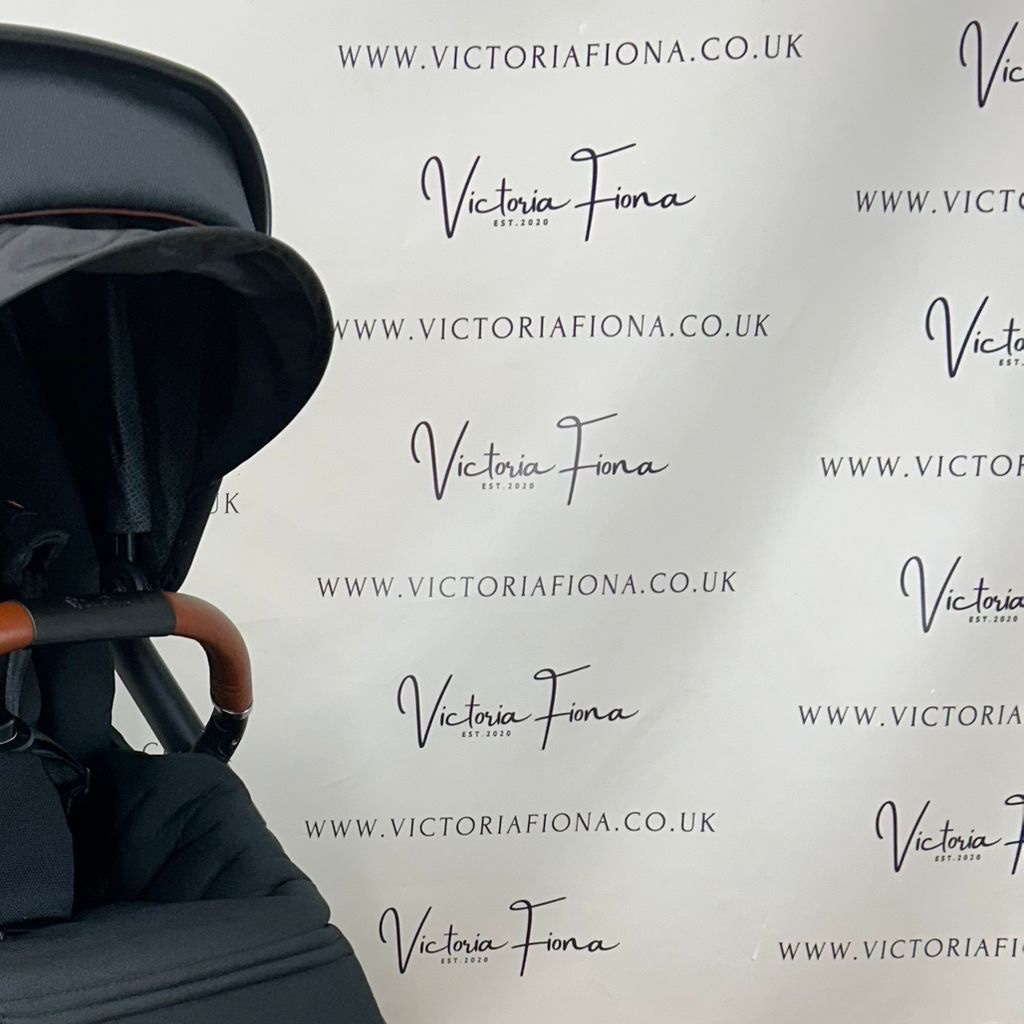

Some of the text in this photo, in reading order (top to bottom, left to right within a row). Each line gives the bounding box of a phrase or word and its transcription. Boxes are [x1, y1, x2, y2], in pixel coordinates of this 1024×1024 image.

[338, 34, 804, 71] WWW.VICTORIAFIONA.CO.UK
[421, 143, 697, 242] Victoria Fiona
[493, 218, 549, 228] EST.2020
[410, 413, 670, 506] Victoria Fiona
[481, 482, 535, 490] EST.2020
[317, 571, 737, 598] WWW.VICTORIAFIONA.CO.UK
[900, 556, 1024, 634] Victoria
[969, 615, 1018, 623] EST.2020
[397, 664, 639, 750] Victoria Fiona
[799, 704, 1023, 727] WWW.VICTORIA
[461, 729, 512, 738] EST.2020
[305, 812, 717, 839] WWW.VICTORIAFIONA.CO.UK
[876, 800, 1002, 873] Victoria
[934, 853, 982, 863] EST.2020
[379, 897, 621, 977] Victoria Fiona
[779, 937, 1024, 961] WWW.VICTORIAFI
